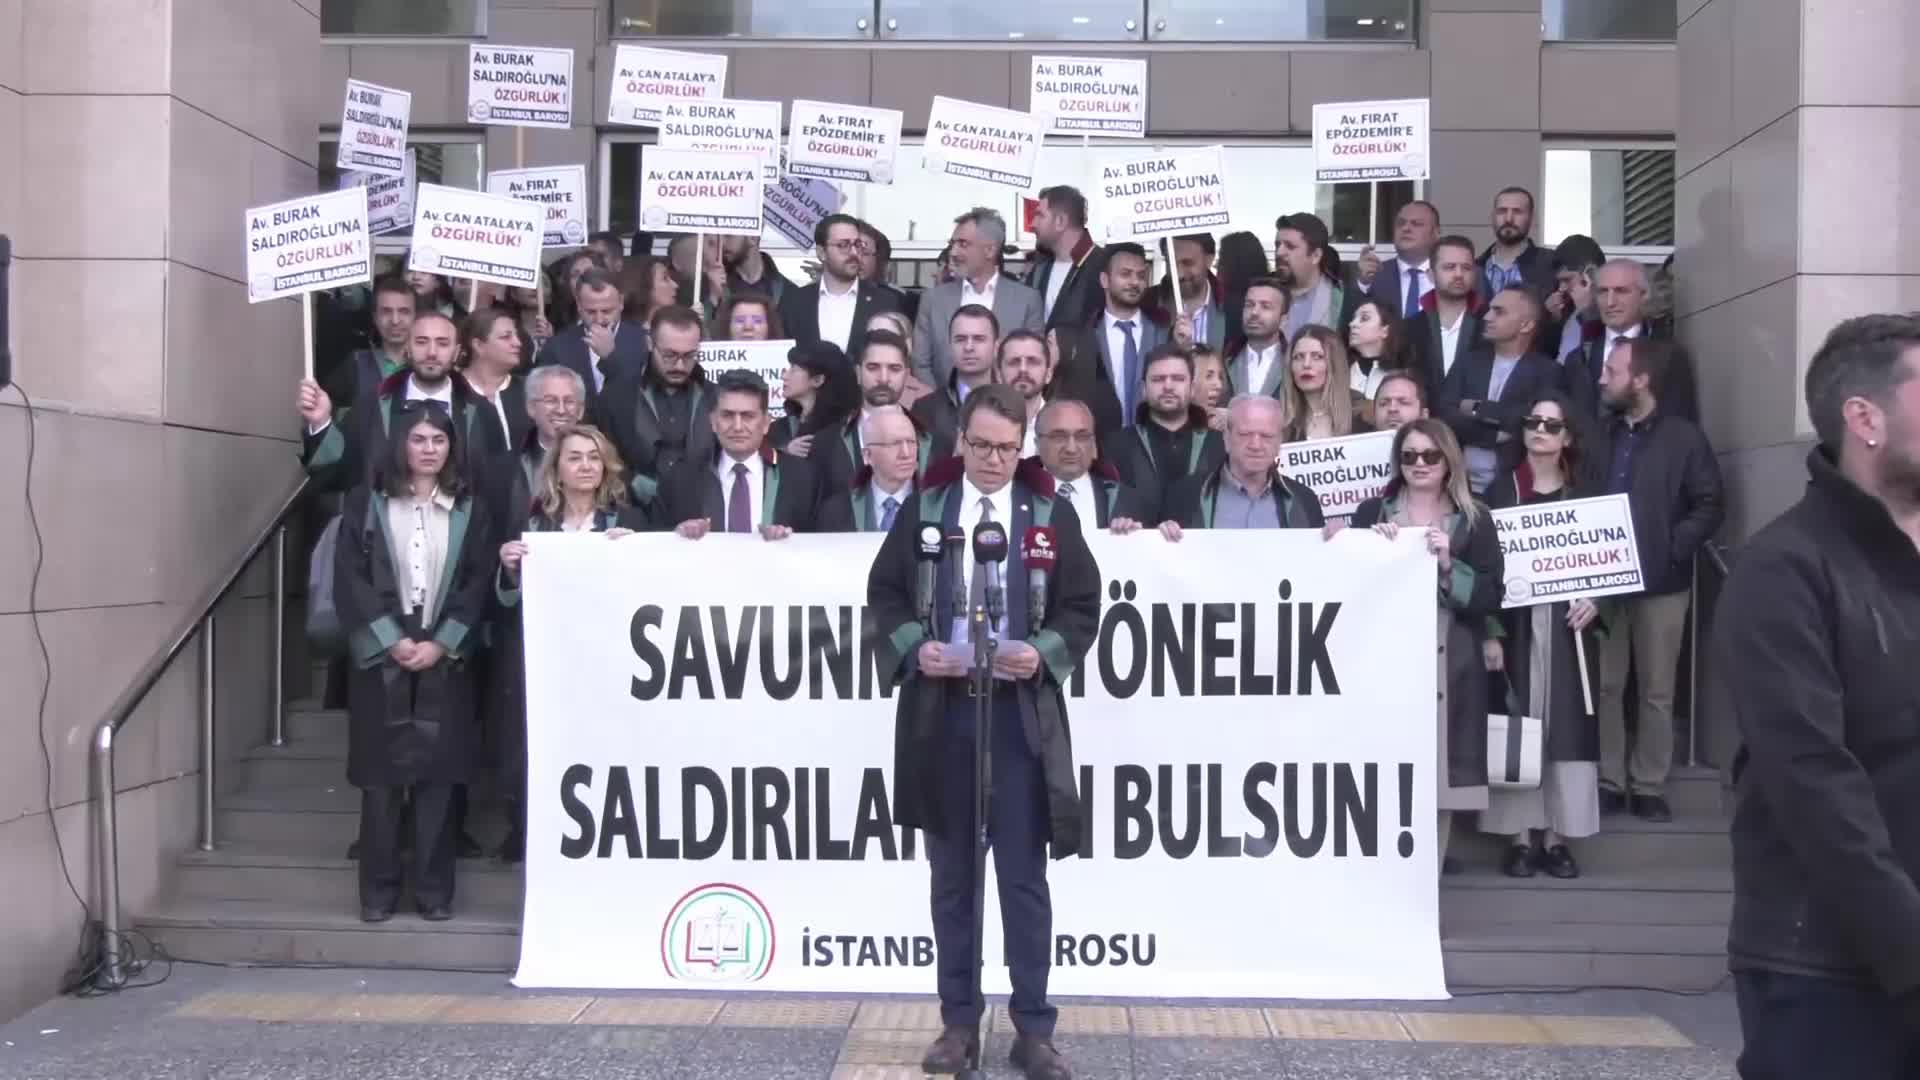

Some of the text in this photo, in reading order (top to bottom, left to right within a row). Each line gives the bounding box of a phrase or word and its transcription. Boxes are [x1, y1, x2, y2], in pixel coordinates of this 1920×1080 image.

[494, 53, 534, 66] BURAK
[638, 70, 661, 80] CAN
[1058, 64, 1103, 76] BURAK
[689, 106, 736, 119] BURAK
[1361, 112, 1399, 124] FIRAT
[838, 116, 873, 128] FIRAT
[953, 123, 977, 135] CAN
[1103, 159, 1176, 179] Av. BURAK
[668, 171, 694, 181] CAN
[526, 179, 559, 191] FIRAT
[273, 205, 320, 226] BURAK
[444, 212, 471, 224] CAN
[697, 349, 747, 362] BURAK
[1288, 446, 1346, 466] BURAK
[1496, 510, 1578, 532] Av. BURAK
[1500, 526, 1627, 554] SALDIROĞLU'NA
[1535, 573, 1638, 595] İSTANBUL BAROSU
[1071, 579, 1341, 699] ÖNELİK
[561, 764, 928, 861] SALDIRILA
[1114, 764, 1378, 860] BULSUN
[1397, 764, 1414, 859] !
[803, 926, 1155, 966] İSTANB ROSU
